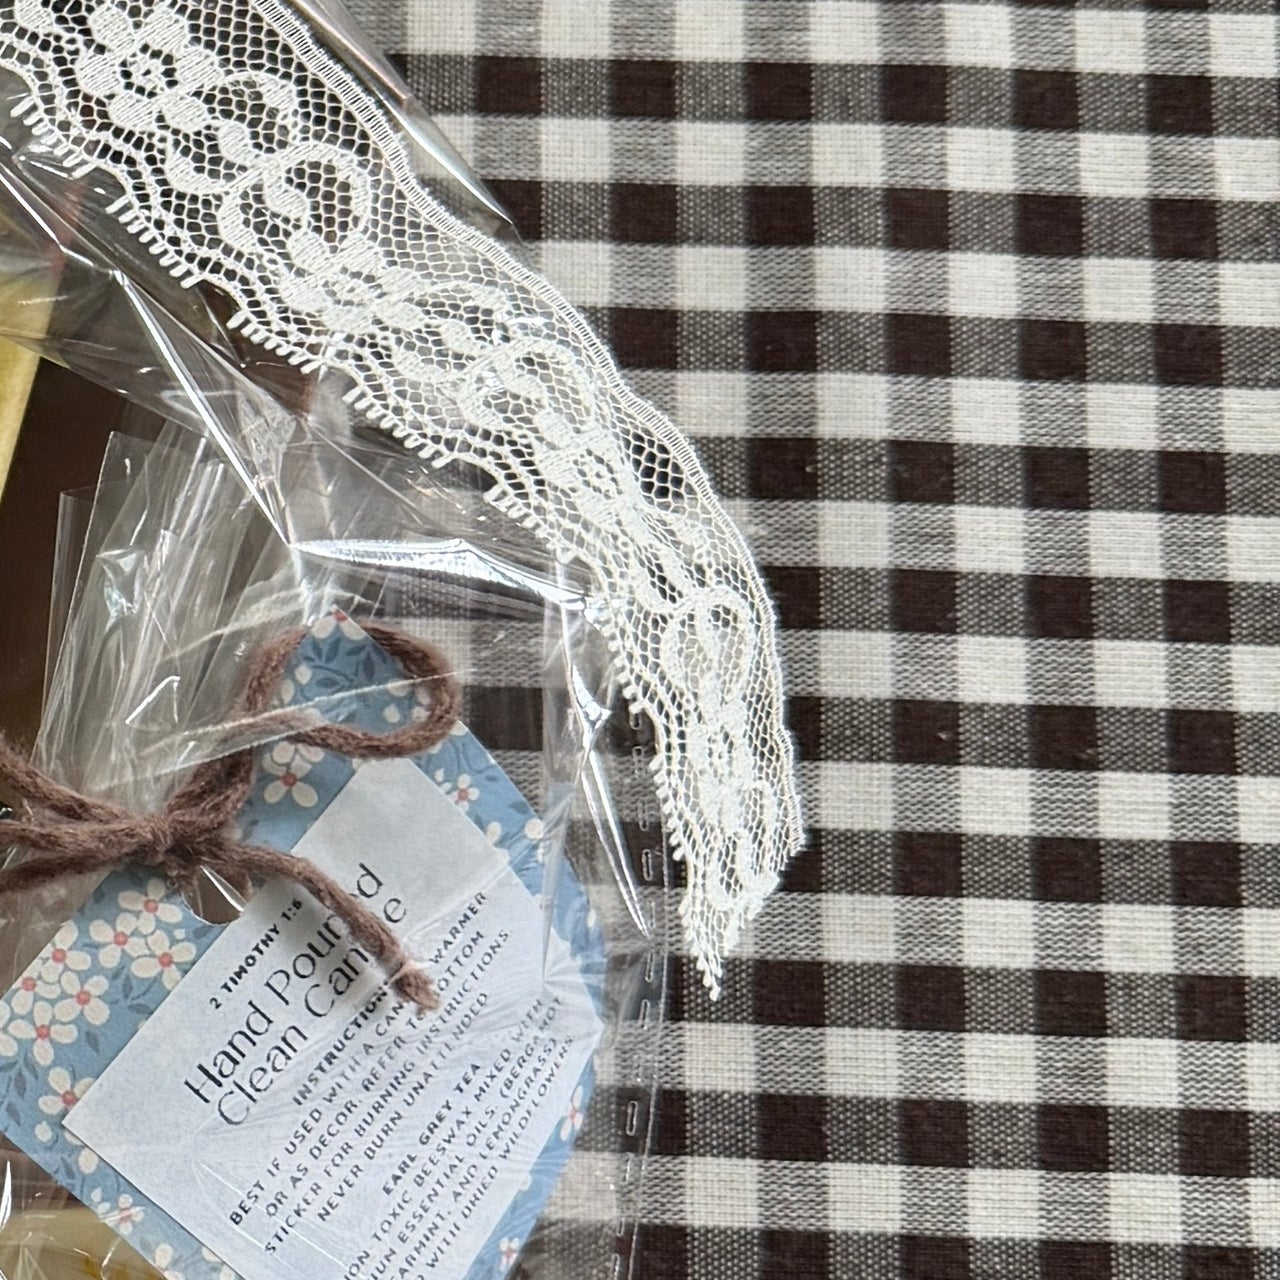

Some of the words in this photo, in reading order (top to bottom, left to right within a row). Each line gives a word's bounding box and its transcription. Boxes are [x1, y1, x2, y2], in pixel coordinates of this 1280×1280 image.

[183, 999, 274, 1104] Hand
[264, 862, 384, 1006] Pourd
[209, 997, 221, 1009] 2
[220, 923, 281, 994] TIMOTHY
[216, 1024, 309, 1126] Clean
[303, 895, 408, 1018] Cane
[229, 1181, 267, 1225] BEST
[266, 1158, 284, 1177] IF
[283, 1107, 324, 1155] USED
[322, 1057, 362, 1104] WITH
[360, 1041, 374, 1055] A
[429, 891, 487, 966] WARMER
[263, 1190, 289, 1218] OR
[287, 1163, 310, 1188] AS
[361, 1036, 405, 1092] REFER
[317, 1164, 364, 1222] NEVER
[363, 1110, 403, 1160] BURN
[403, 992, 489, 1106] UNATTENDED
[382, 1151, 418, 1195] EARL
[417, 1100, 454, 1146] GREY
[454, 1061, 481, 1094] TEA
[413, 1106, 472, 1187] BEESWAX
[473, 1048, 513, 1101] MIXED
[263, 1182, 323, 1256] STICKER
[323, 1141, 354, 1177] FOR
[354, 1059, 415, 1137] BURNING
[396, 1153, 465, 1243] ESSENTIAL
[425, 1223, 460, 1269] WITH
[459, 1165, 499, 1219] DRIED
[449, 1163, 479, 1202] AND
